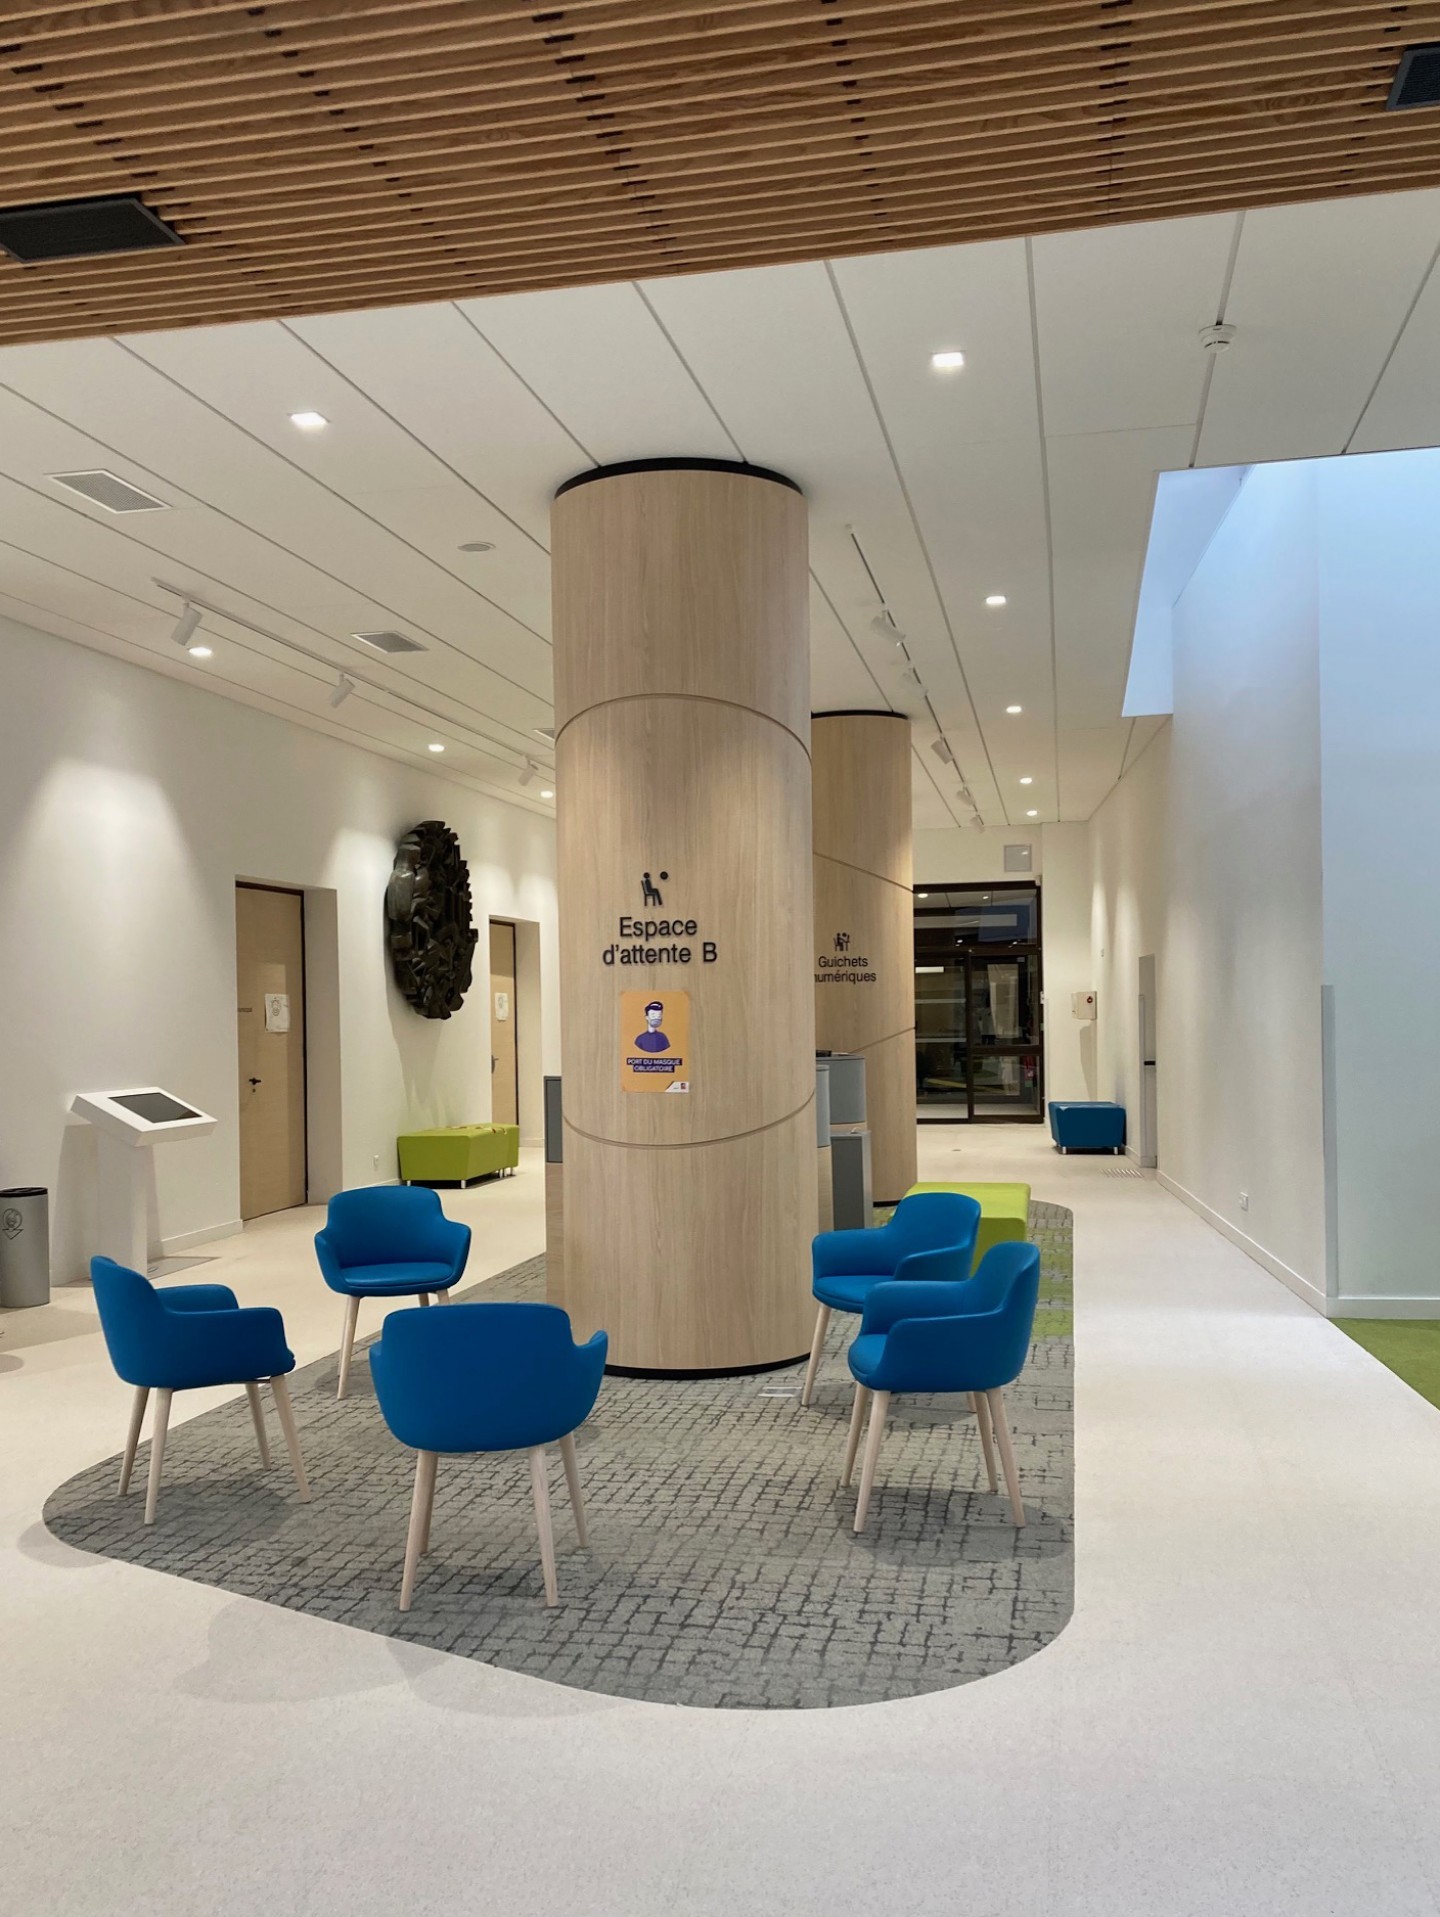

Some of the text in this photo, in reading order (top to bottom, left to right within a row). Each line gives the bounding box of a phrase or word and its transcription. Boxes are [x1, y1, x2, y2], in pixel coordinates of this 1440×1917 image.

[619, 916, 698, 941] Espace
[602, 942, 718, 965] d'attente B
[818, 956, 869, 967] Guichets
